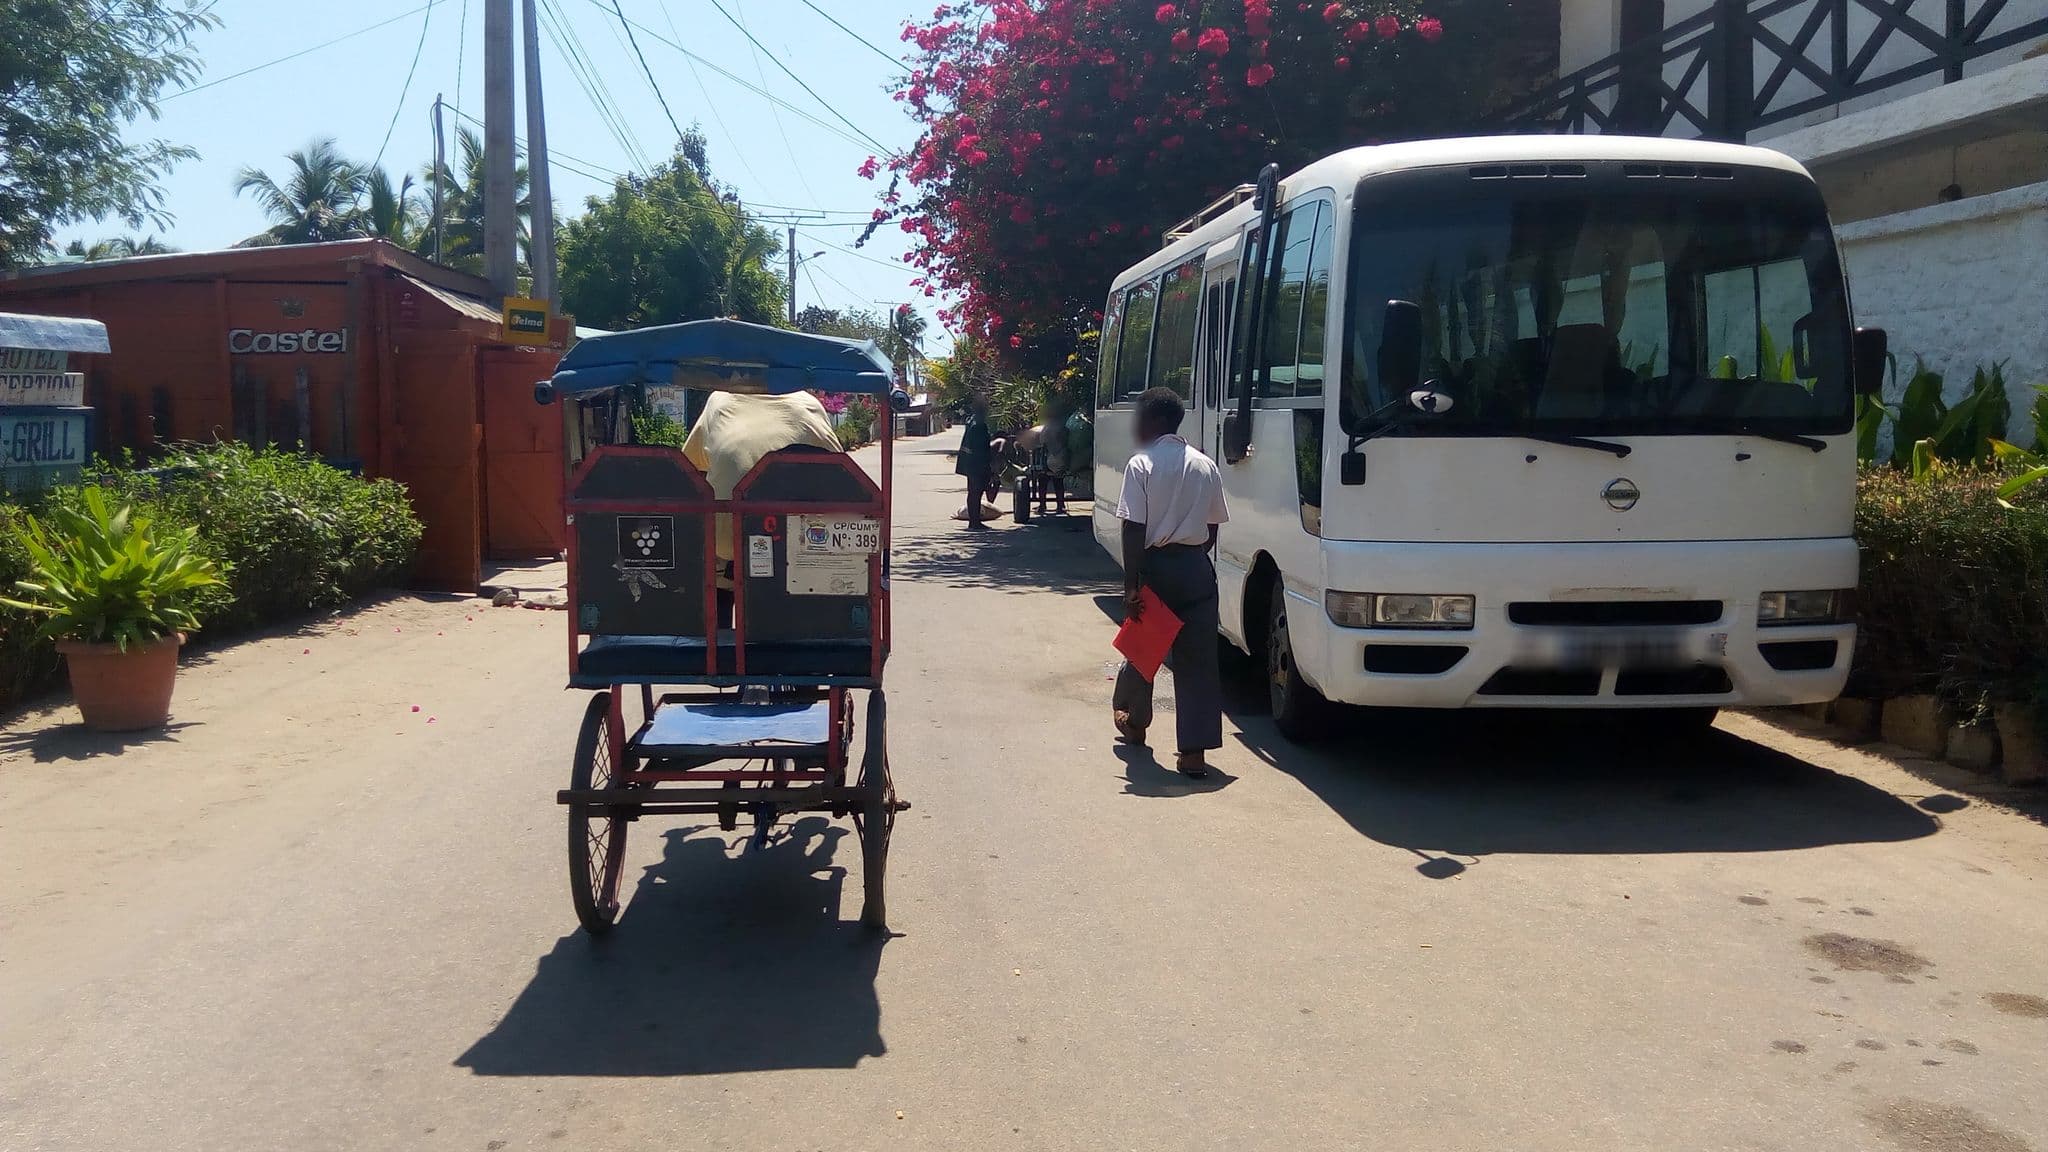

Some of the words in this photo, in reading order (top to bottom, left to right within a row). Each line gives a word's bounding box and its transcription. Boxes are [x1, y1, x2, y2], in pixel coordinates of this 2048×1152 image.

[511, 315, 543, 327] Telma
[229, 328, 347, 353] Castel
[855, 534, 877, 548] 389
